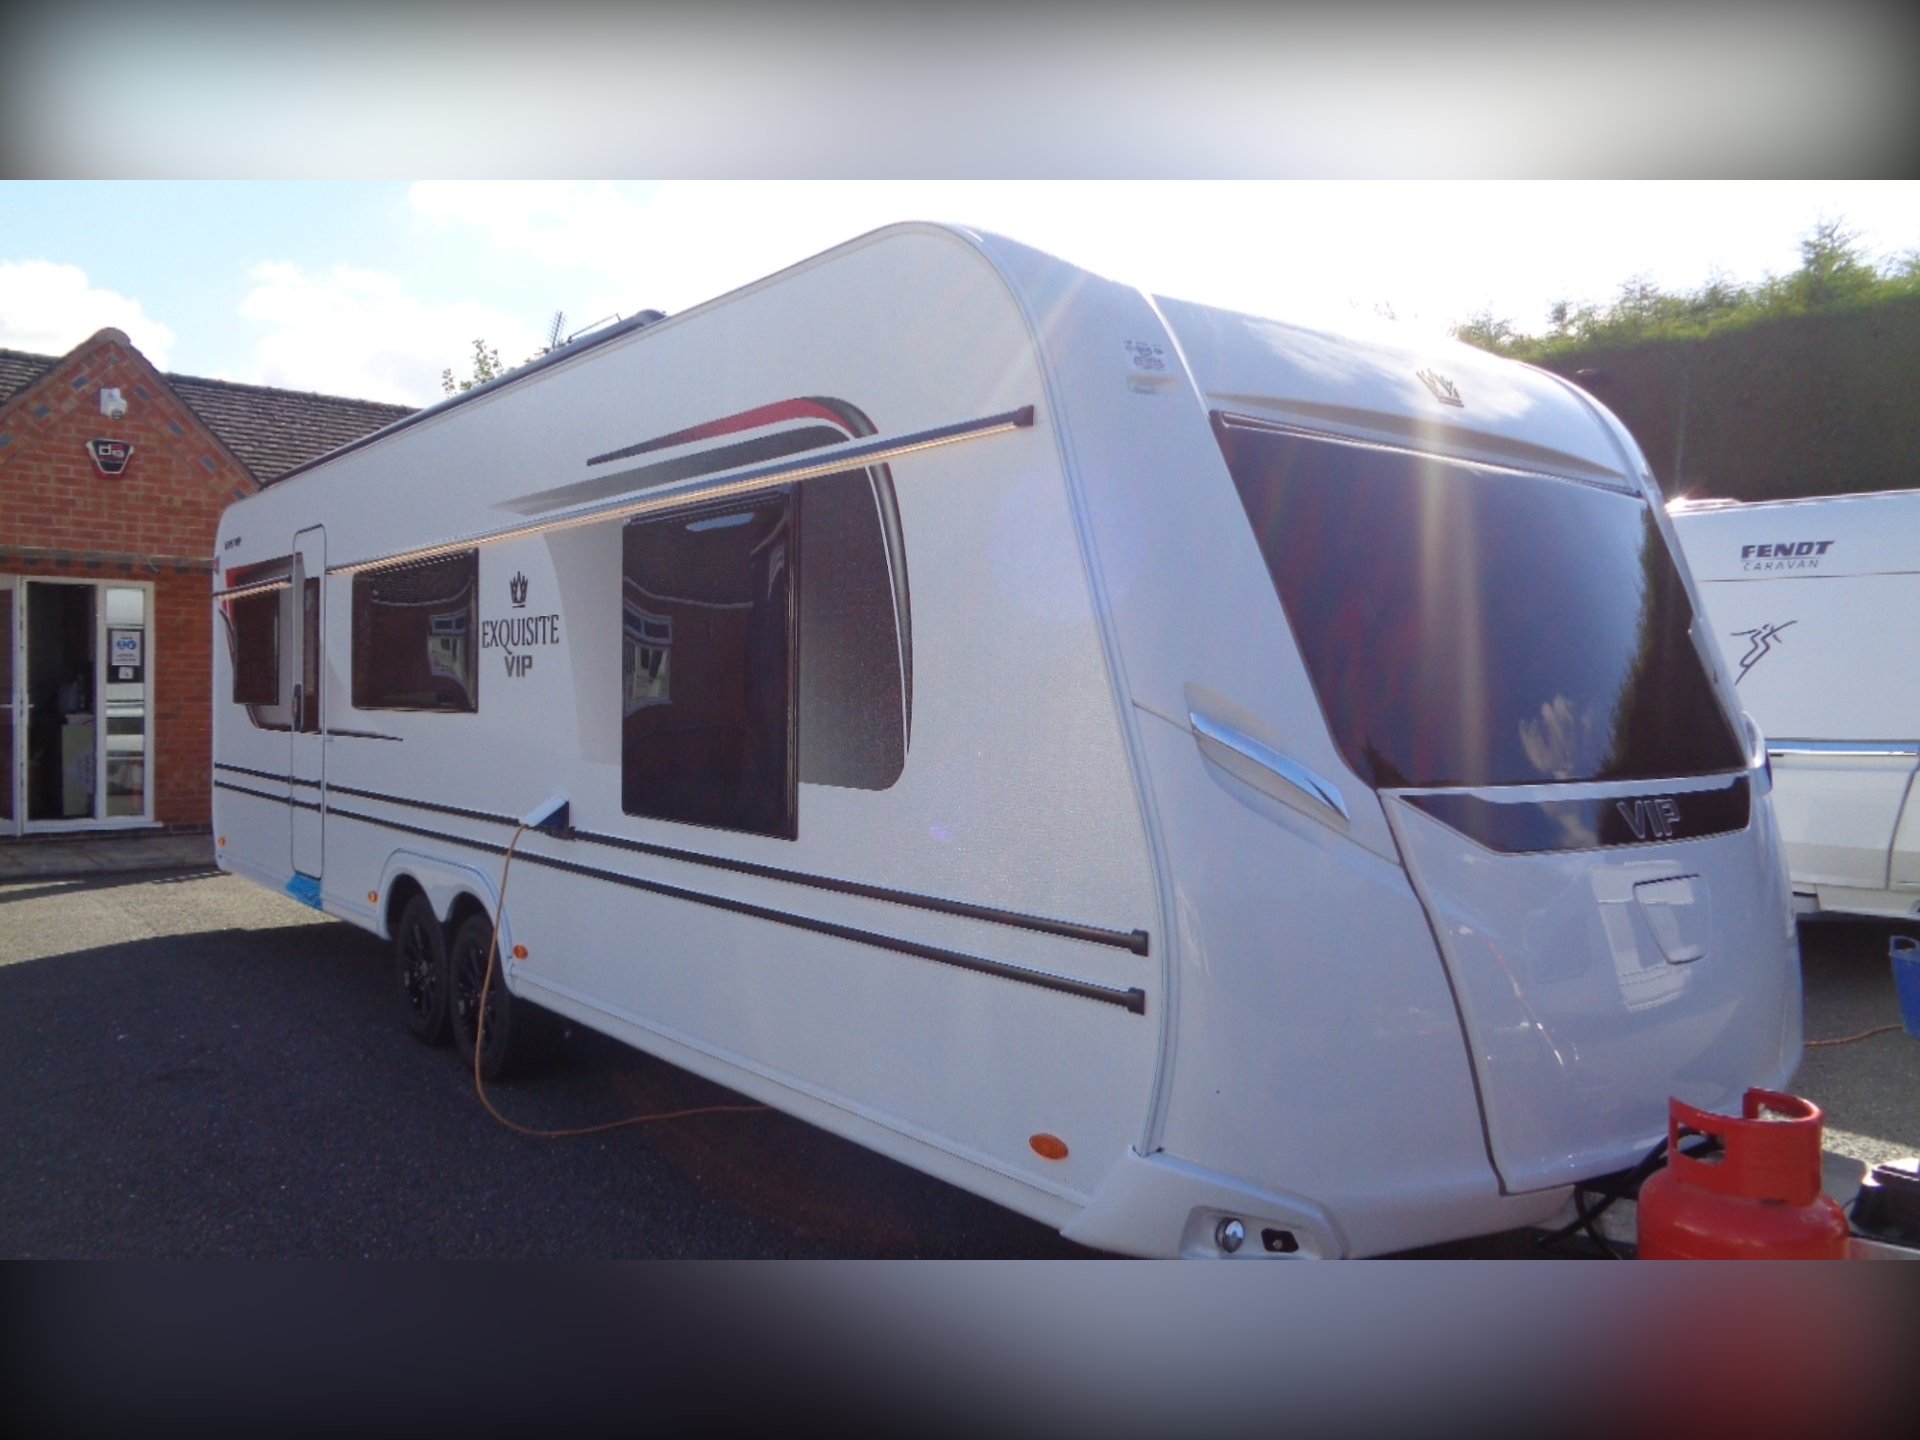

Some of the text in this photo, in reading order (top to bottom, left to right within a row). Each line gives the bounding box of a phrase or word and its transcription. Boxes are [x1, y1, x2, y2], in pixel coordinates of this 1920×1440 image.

[1740, 540, 1835, 559] FENDT
[1743, 559, 1820, 572] CARAVAN
[481, 614, 560, 655] EXQUISITE
[504, 654, 533, 678] VIP
[1616, 798, 1681, 840] VIP
